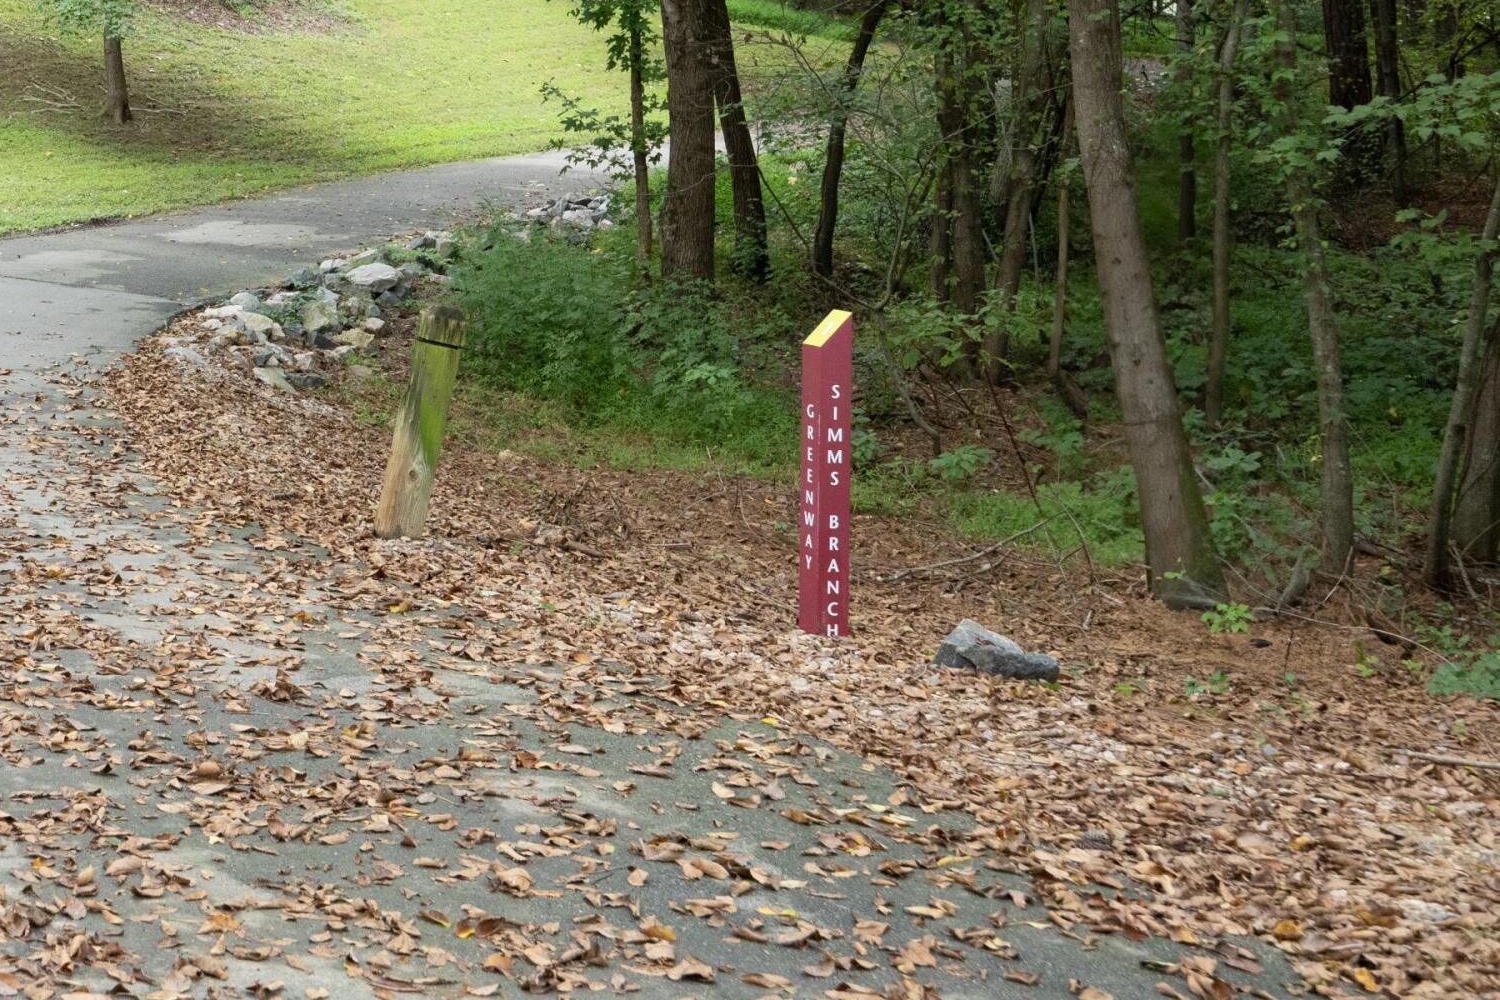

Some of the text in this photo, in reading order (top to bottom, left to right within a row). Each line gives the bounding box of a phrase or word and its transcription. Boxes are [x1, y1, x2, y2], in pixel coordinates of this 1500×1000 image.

[803, 403, 815, 570] GREENWAY
[826, 384, 843, 637] SIMMS BRANCH
